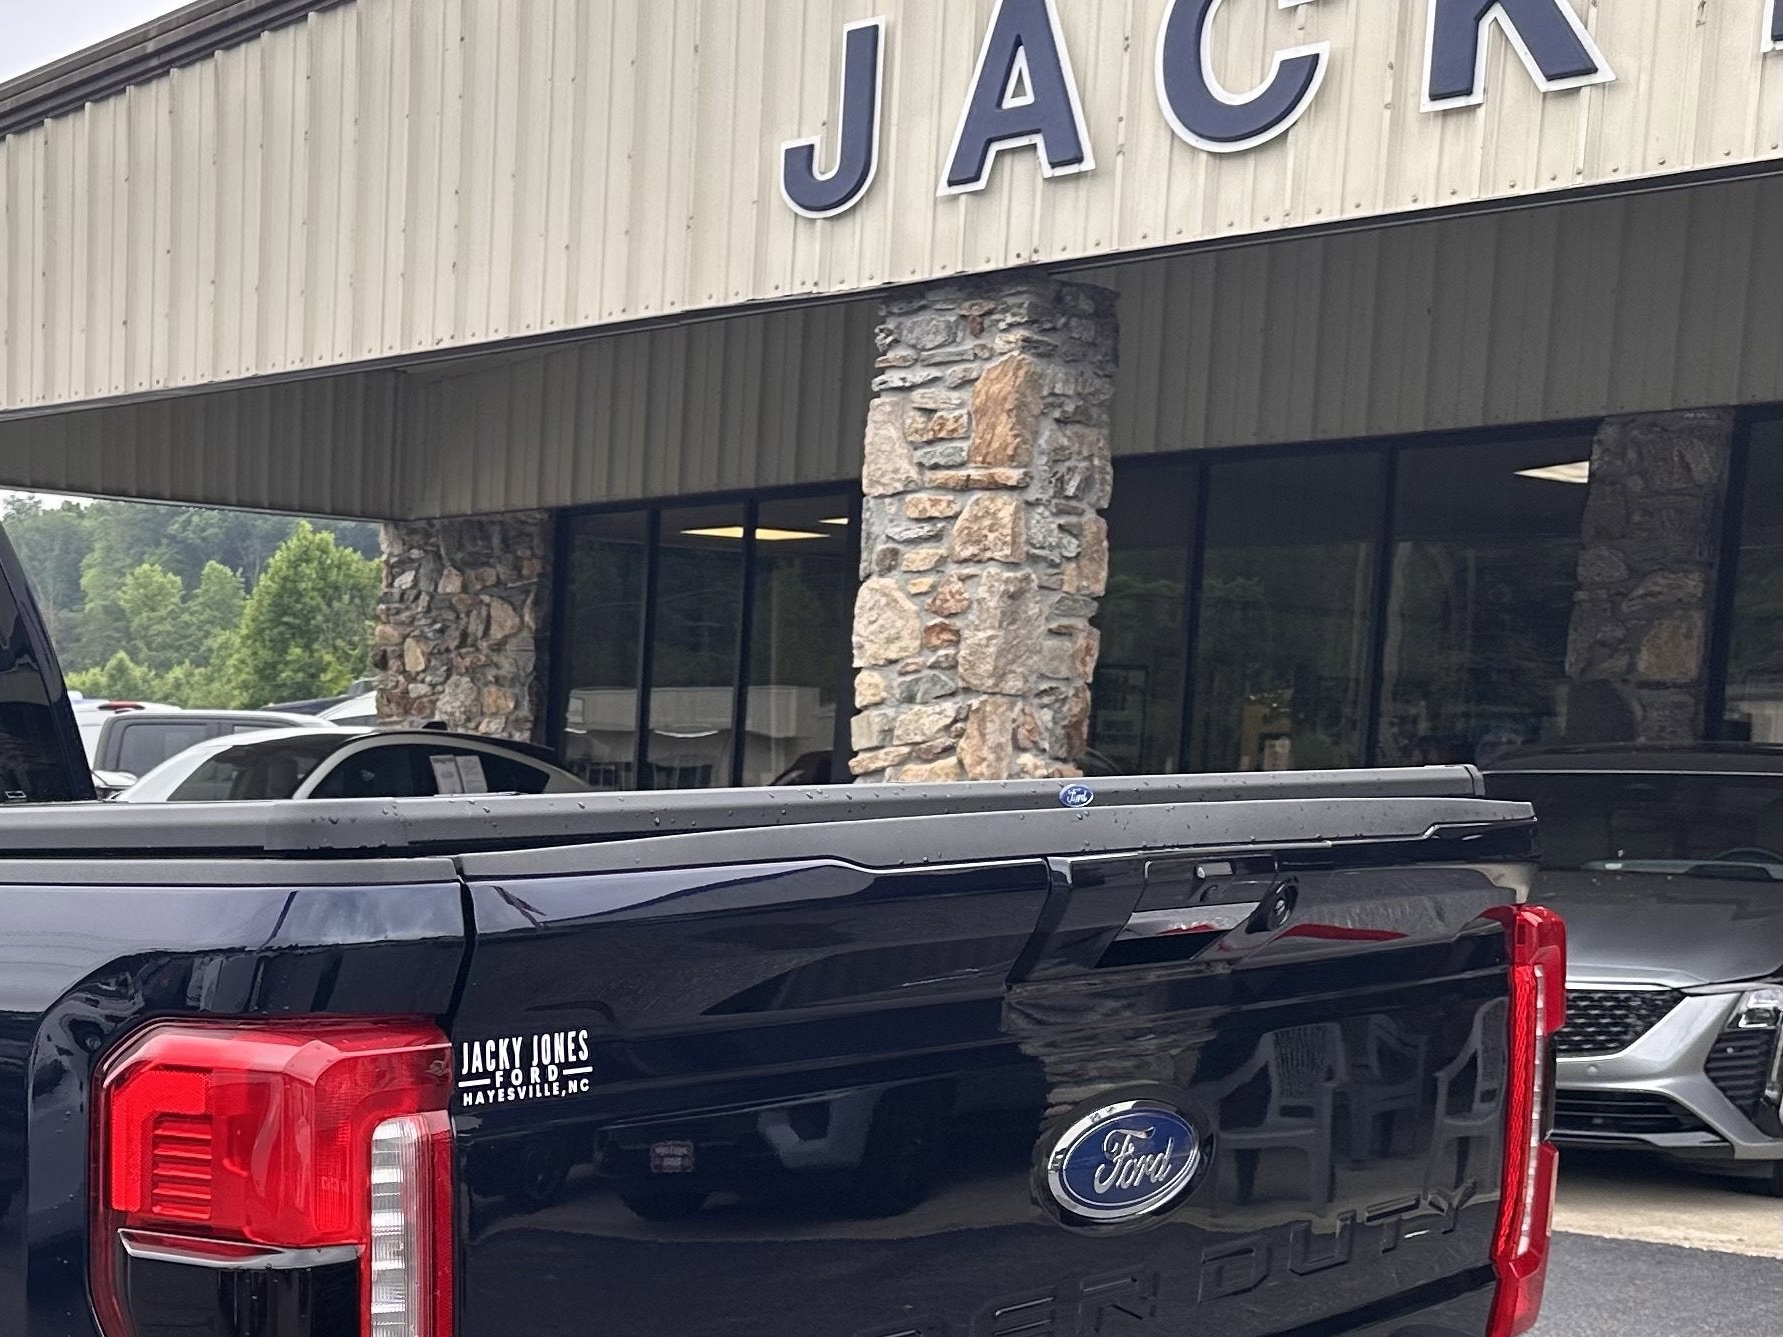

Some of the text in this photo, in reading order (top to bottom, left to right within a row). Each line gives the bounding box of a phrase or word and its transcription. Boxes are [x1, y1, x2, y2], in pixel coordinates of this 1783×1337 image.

[781, 0, 1783, 220] JACK
[461, 1029, 590, 1076] JACKY JONES
[495, 1065, 559, 1088] FORD
[1093, 1126, 1175, 1195] Ford
[1197, 1178, 1477, 1304] DUTY
